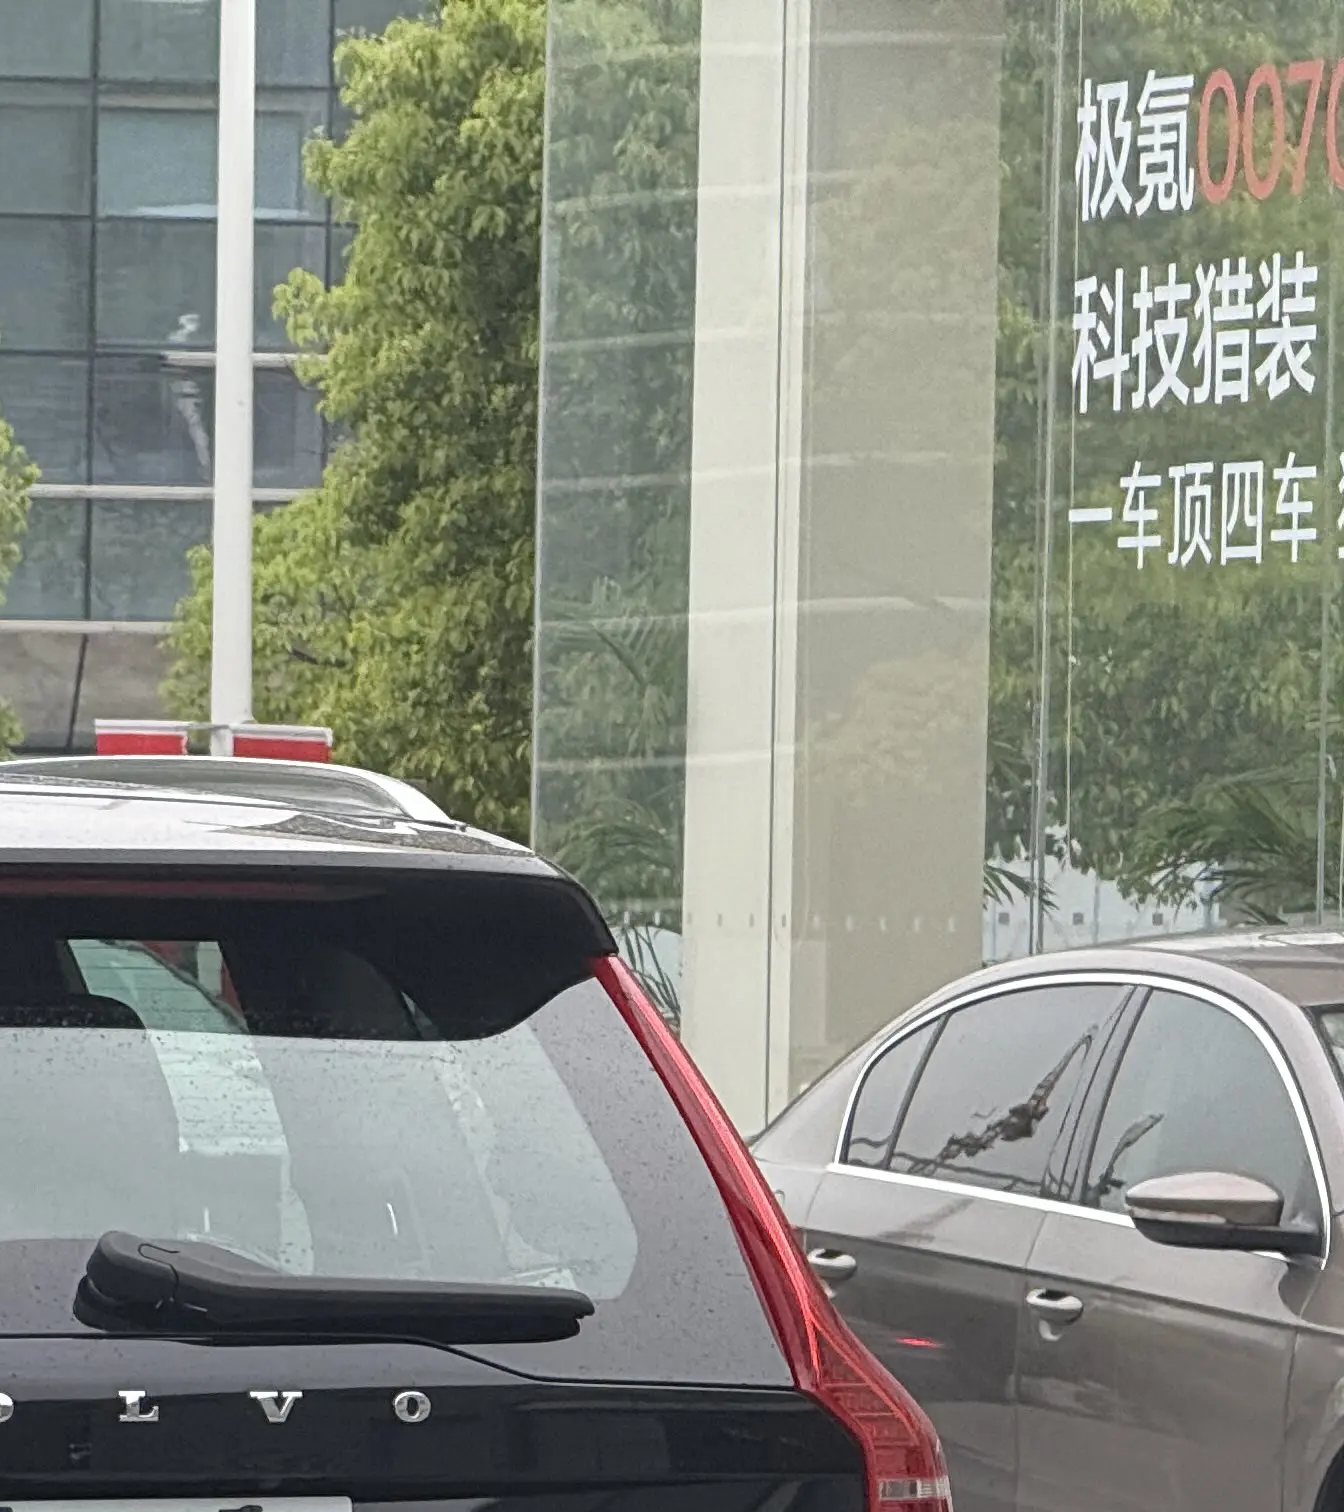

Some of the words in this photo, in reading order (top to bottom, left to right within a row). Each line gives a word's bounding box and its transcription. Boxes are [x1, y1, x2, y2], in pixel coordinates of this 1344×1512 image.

[1071, 250, 1319, 414] 科技猎装
[1069, 452, 1318, 570] 一车顶四车
